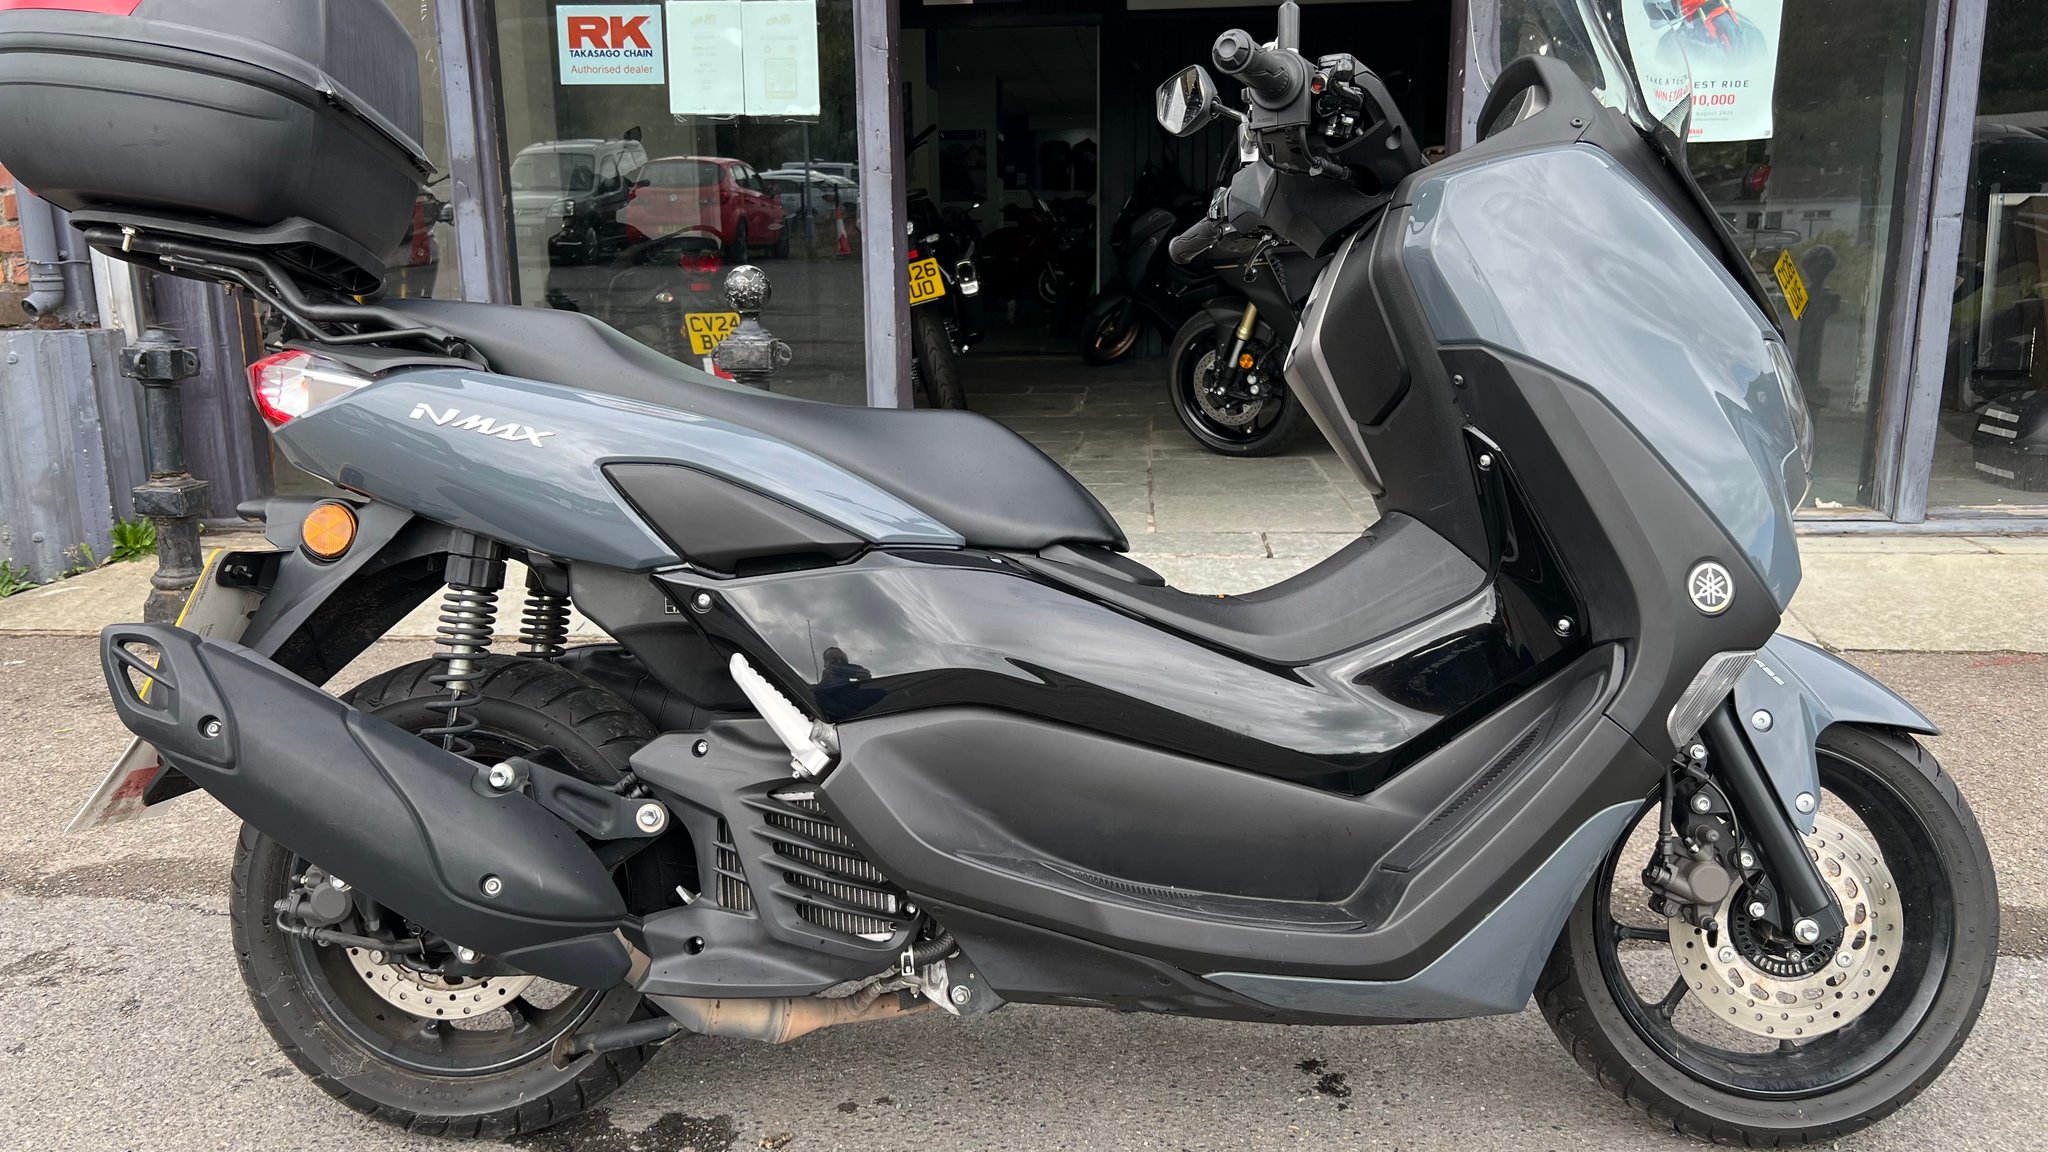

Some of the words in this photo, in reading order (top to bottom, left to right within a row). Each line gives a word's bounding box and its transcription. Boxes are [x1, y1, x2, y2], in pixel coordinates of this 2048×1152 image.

[567, 16, 652, 49] RK
[569, 50, 620, 58] TAKASAGO
[624, 50, 653, 58] CHAIN
[571, 65, 621, 74] Authorised
[624, 65, 653, 74] dealer
[1721, 80, 1750, 89] RIDE
[1653, 88, 1668, 102] WIN
[689, 316, 739, 332] CV24
[409, 402, 556, 448] NMAX
